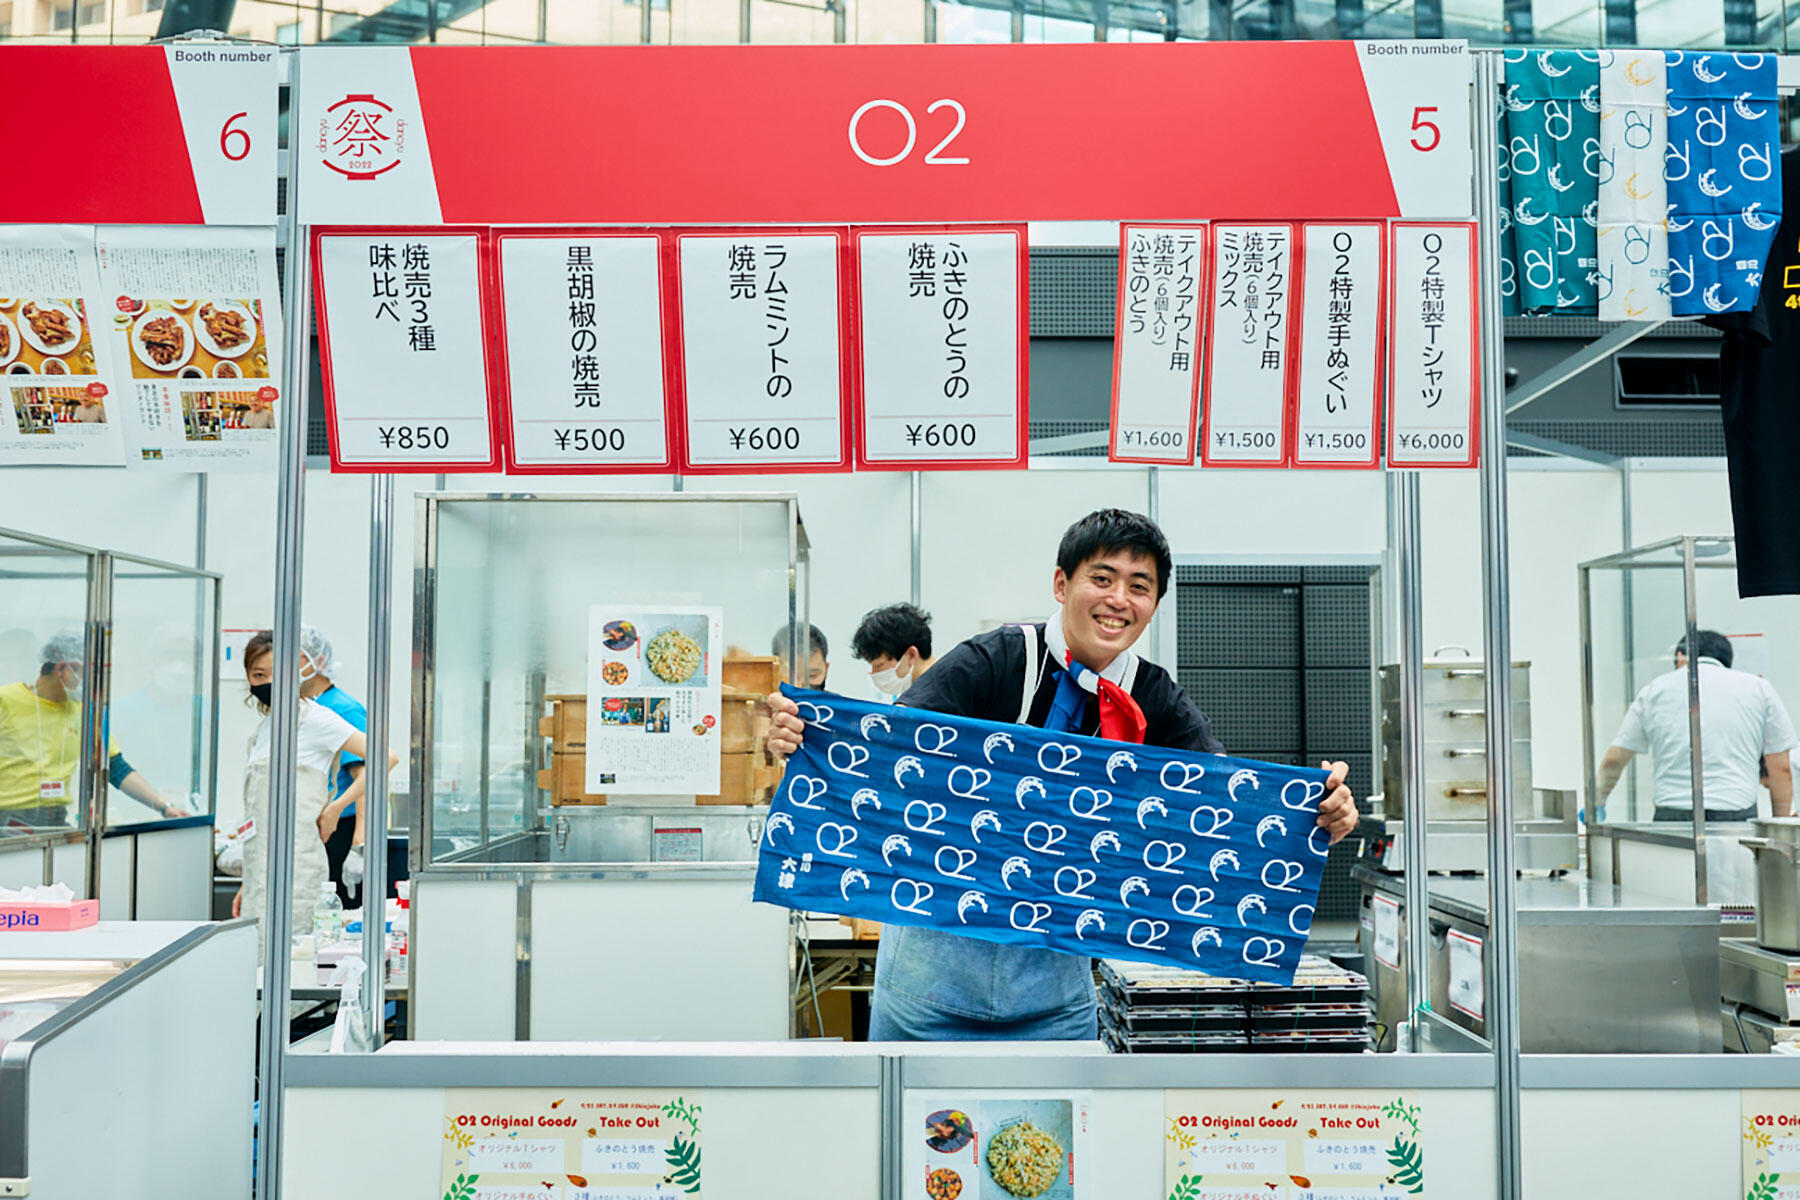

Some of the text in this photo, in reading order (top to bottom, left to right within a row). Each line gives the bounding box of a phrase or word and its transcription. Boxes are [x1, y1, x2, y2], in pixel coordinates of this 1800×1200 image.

[175, 50, 272, 62] Booth number
[1367, 42, 1464, 55] Booth number
[220, 111, 251, 162] 6
[316, 118, 330, 153] dancyu
[332, 108, 391, 158] 祭
[396, 118, 408, 153] dancyu
[848, 98, 970, 166] O2
[1410, 106, 1441, 153] 5
[349, 160, 372, 169] 2022
[369, 243, 401, 322] 味比べ
[728, 244, 757, 300] 焼売
[908, 242, 936, 298] 焼売
[1129, 234, 1151, 334] ふきのとう
[1220, 232, 1240, 308] ミックス
[402, 243, 437, 352] 焼売3種
[1169, 235, 1196, 372] テイクアウト用
[1260, 232, 1286, 370] テイクアウト用
[566, 246, 601, 408] 黒胡椒の焼売
[763, 244, 792, 398] ラムミントの
[942, 242, 970, 399] ふきのとうの
[1326, 232, 1354, 414] O2特製手ぬぐい
[1421, 233, 1445, 409] O2特製Tシャツ
[378, 425, 449, 450] ¥850
[554, 428, 625, 451] ¥500
[729, 426, 800, 450] ¥600
[905, 423, 976, 447] ¥600
[1123, 430, 1183, 447] ¥1,600
[1215, 432, 1276, 448] ¥1,500
[1304, 433, 1366, 449] ¥1,500
[1398, 433, 1464, 450] ¥6,000
[457, 1115, 578, 1130] O2 Original Goods
[600, 1117, 660, 1128] Take Out
[1178, 1115, 1298, 1130] O2 Original Goods
[1320, 1117, 1380, 1129] Take Out
[1755, 1115, 1774, 1126] O2
